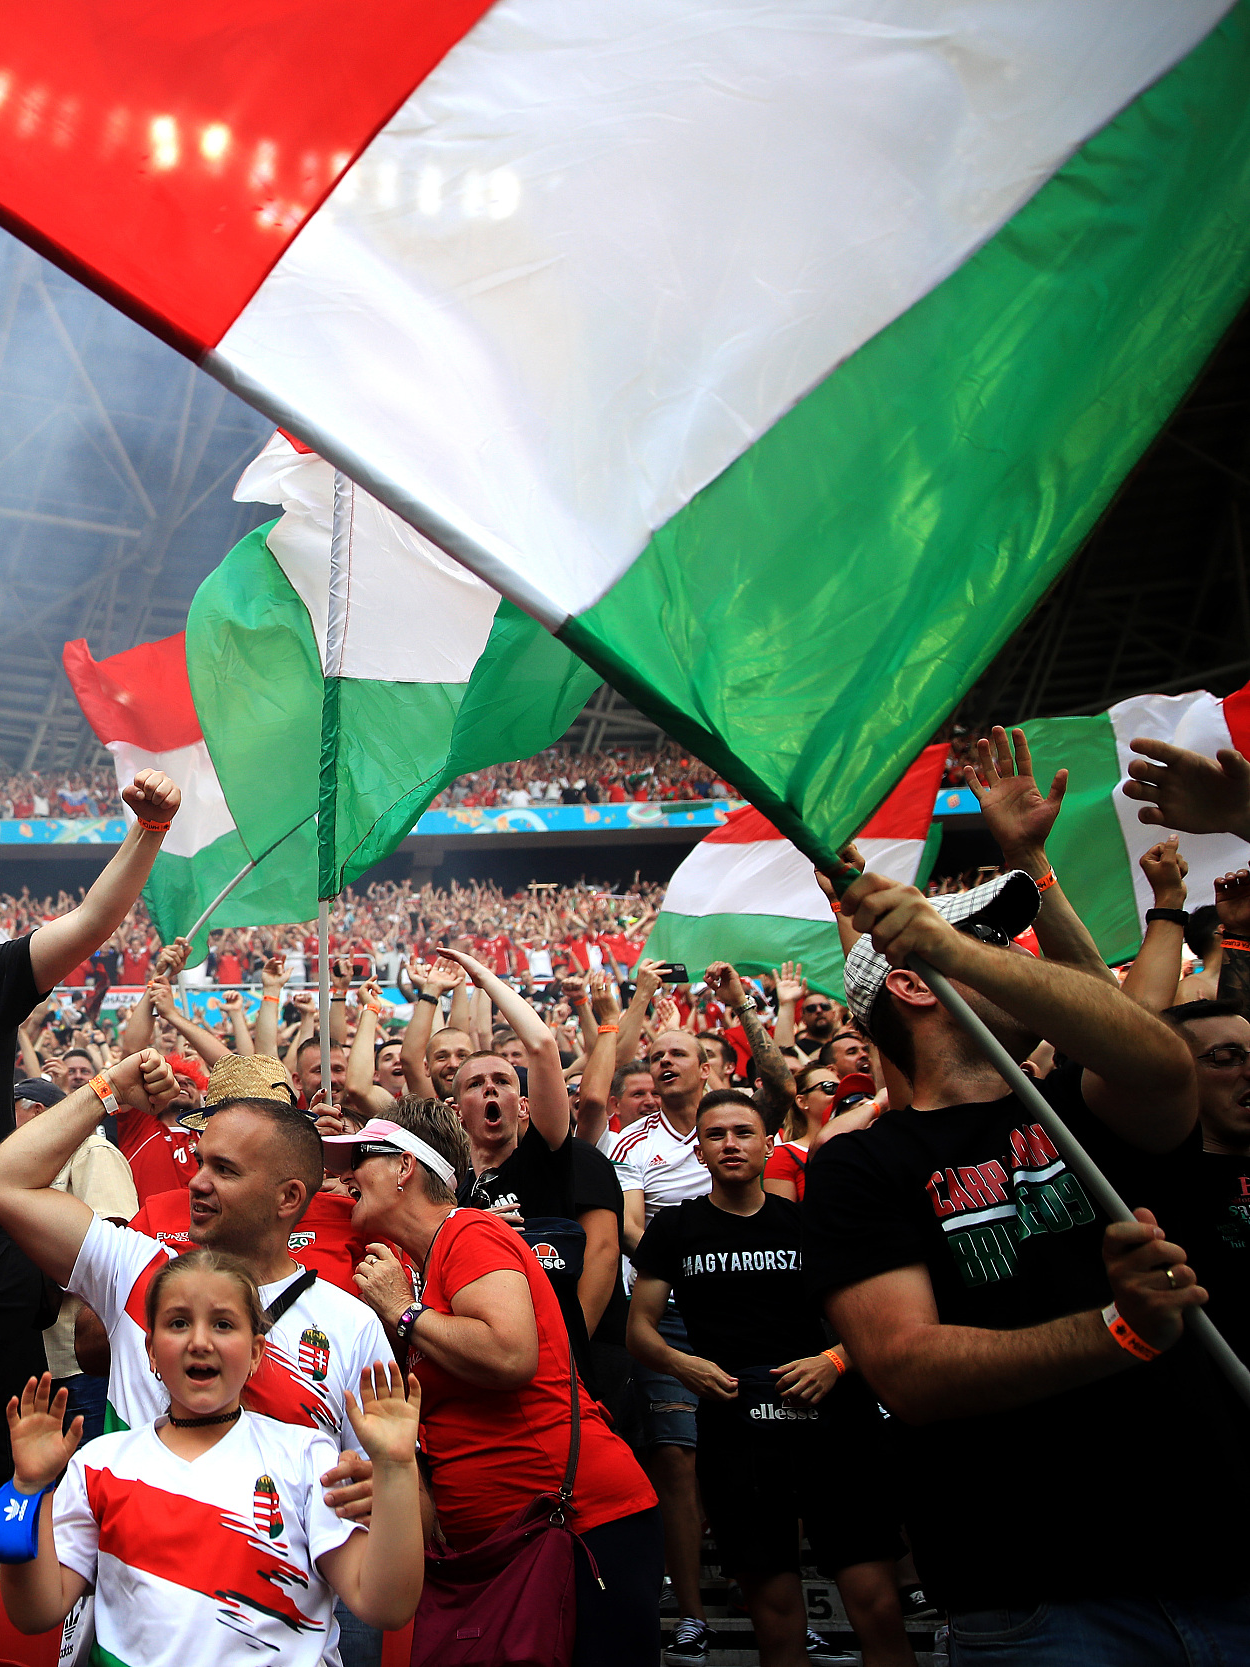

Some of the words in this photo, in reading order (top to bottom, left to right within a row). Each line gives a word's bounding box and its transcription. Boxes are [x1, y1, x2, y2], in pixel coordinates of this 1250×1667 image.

[925, 1123, 1060, 1218] CARPAN
[682, 1250, 802, 1277] MAGYARORSZ
[750, 1403, 819, 1420] ellesse
